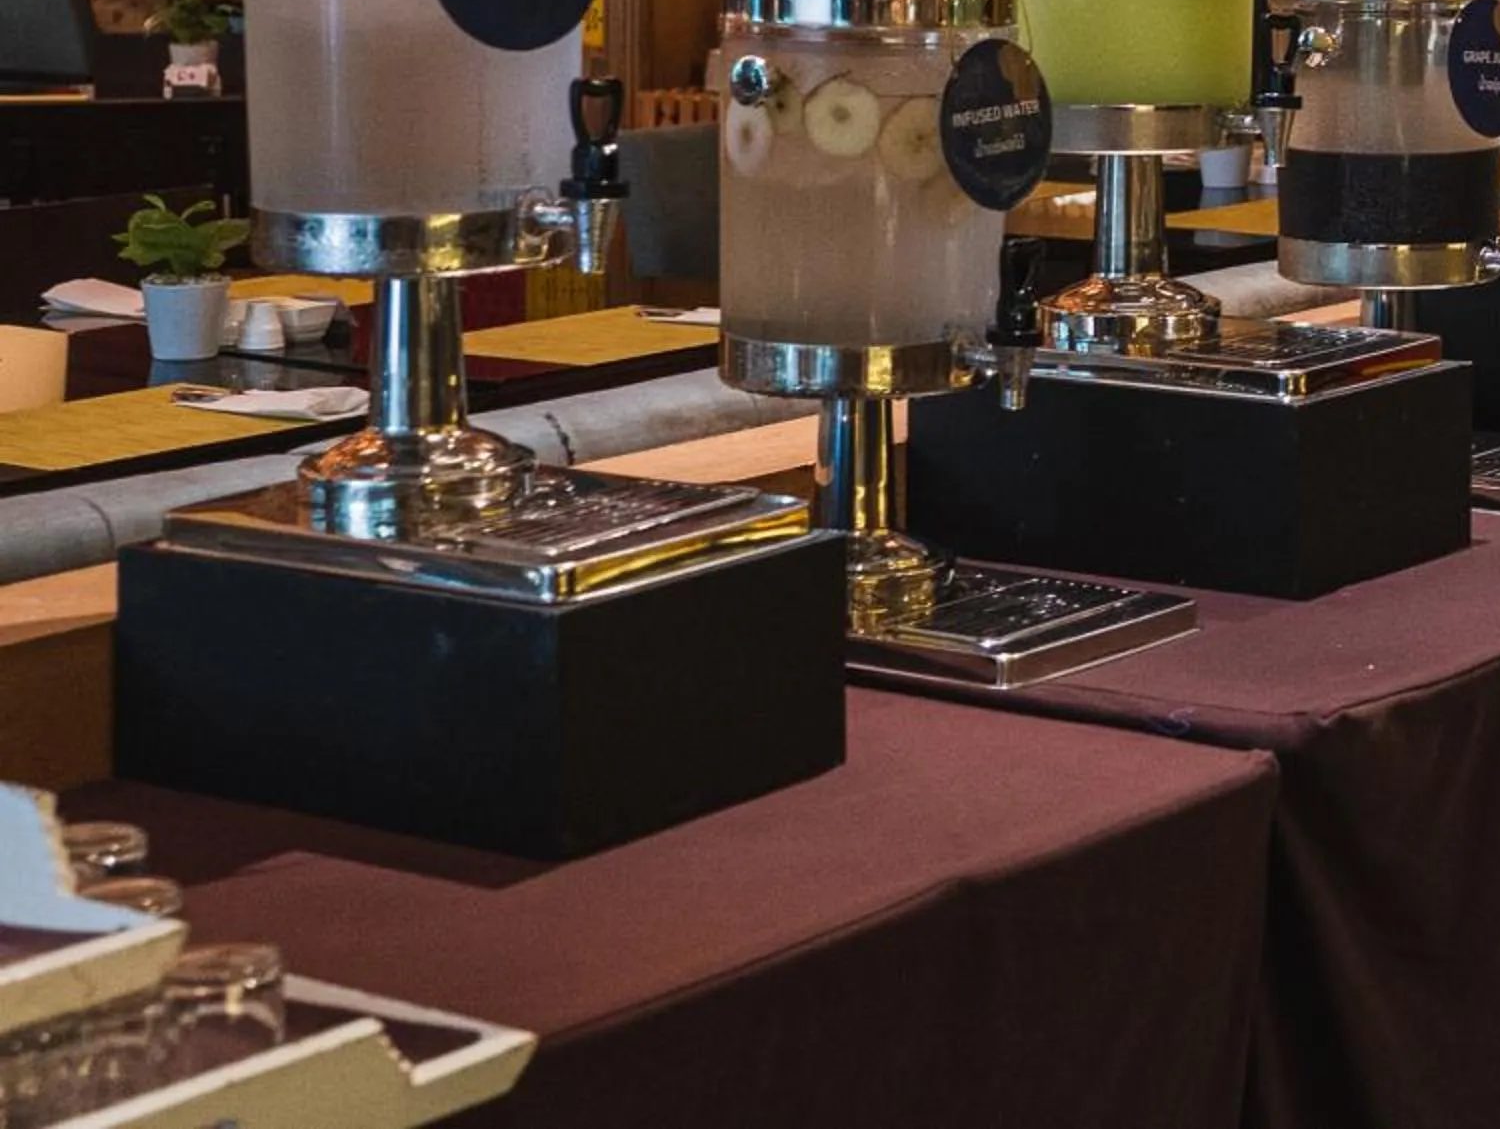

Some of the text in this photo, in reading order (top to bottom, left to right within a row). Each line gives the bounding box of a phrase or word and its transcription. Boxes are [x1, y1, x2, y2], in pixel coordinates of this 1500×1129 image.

[1463, 49, 1491, 64] GRAPE
[952, 98, 1041, 127] INFUSED WATER
